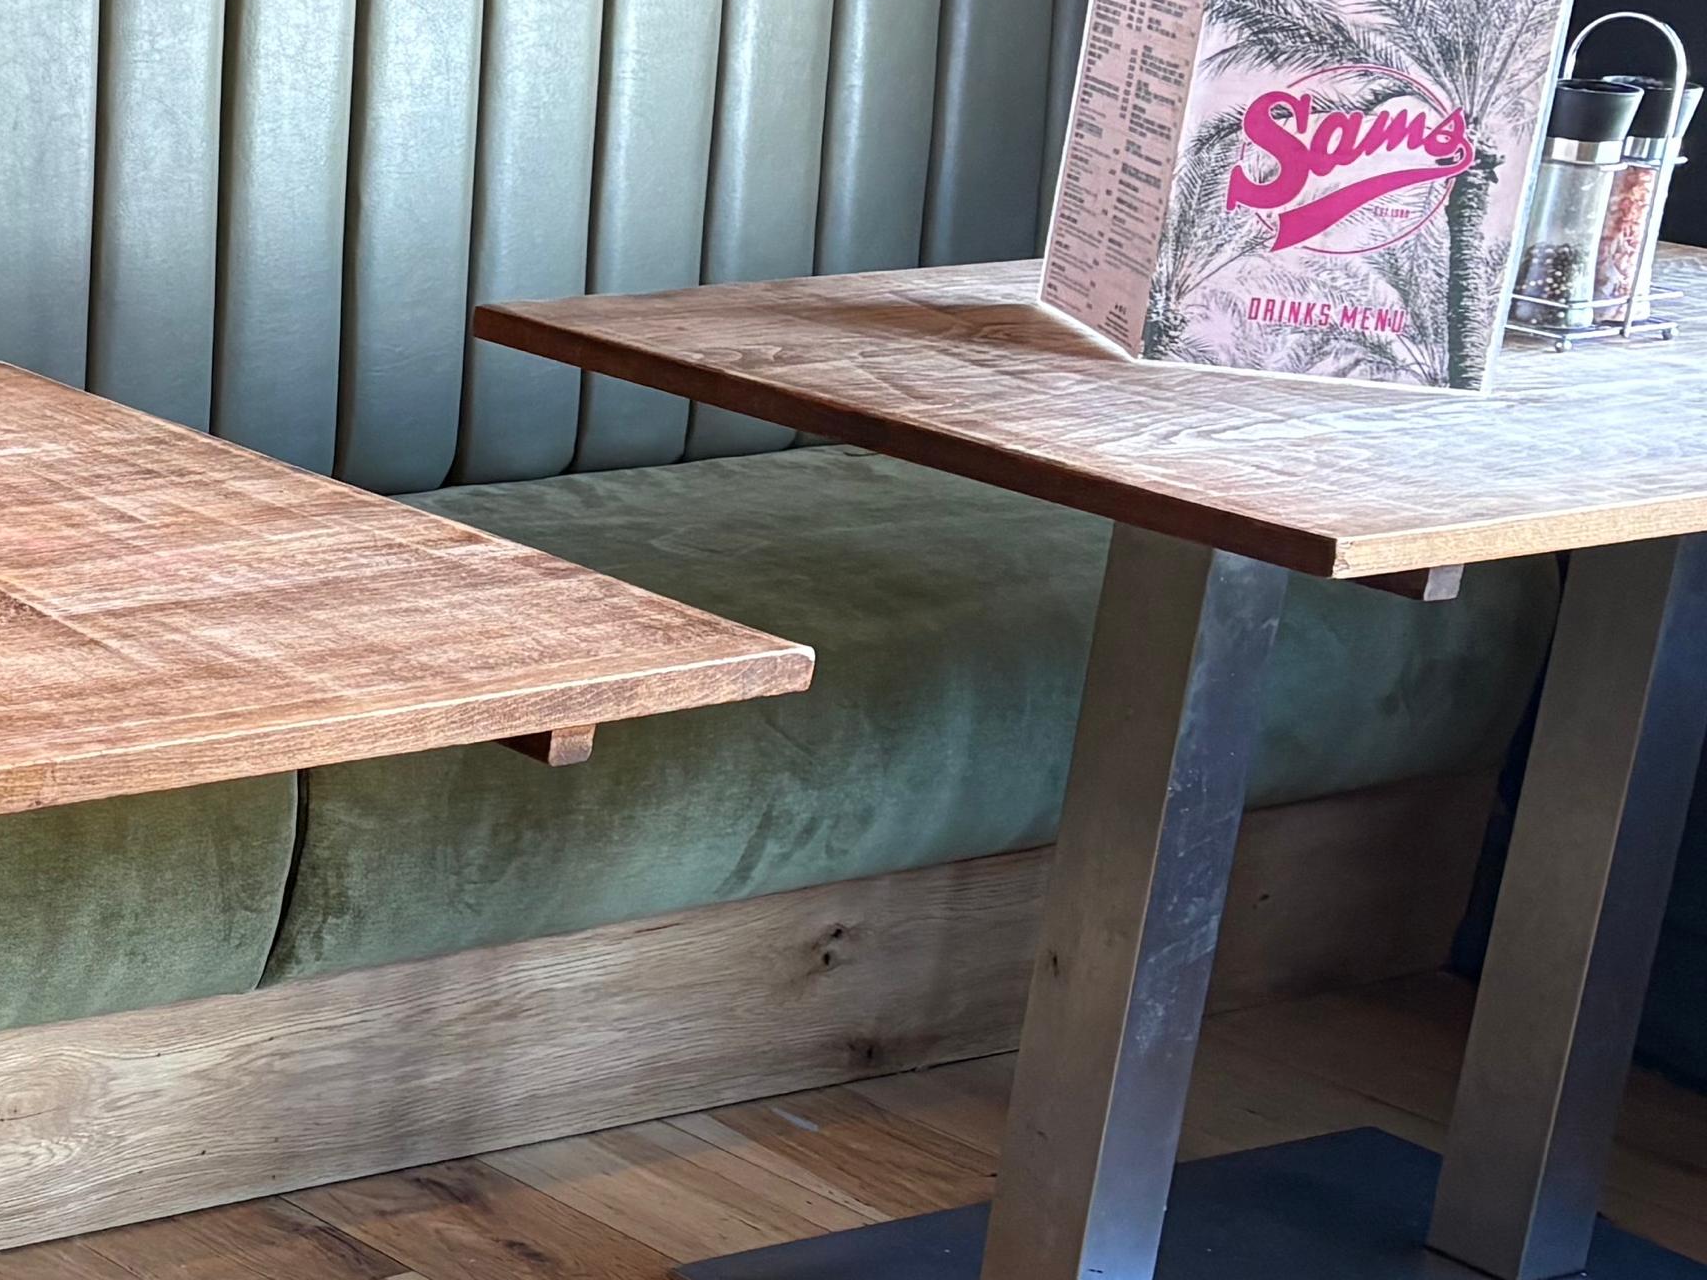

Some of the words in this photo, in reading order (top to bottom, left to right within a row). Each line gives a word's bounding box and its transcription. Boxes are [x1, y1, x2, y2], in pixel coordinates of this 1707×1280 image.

[1226, 89, 1469, 213] Sams
[1248, 298, 1331, 326] DRINKS
[1340, 305, 1404, 333] MENU
